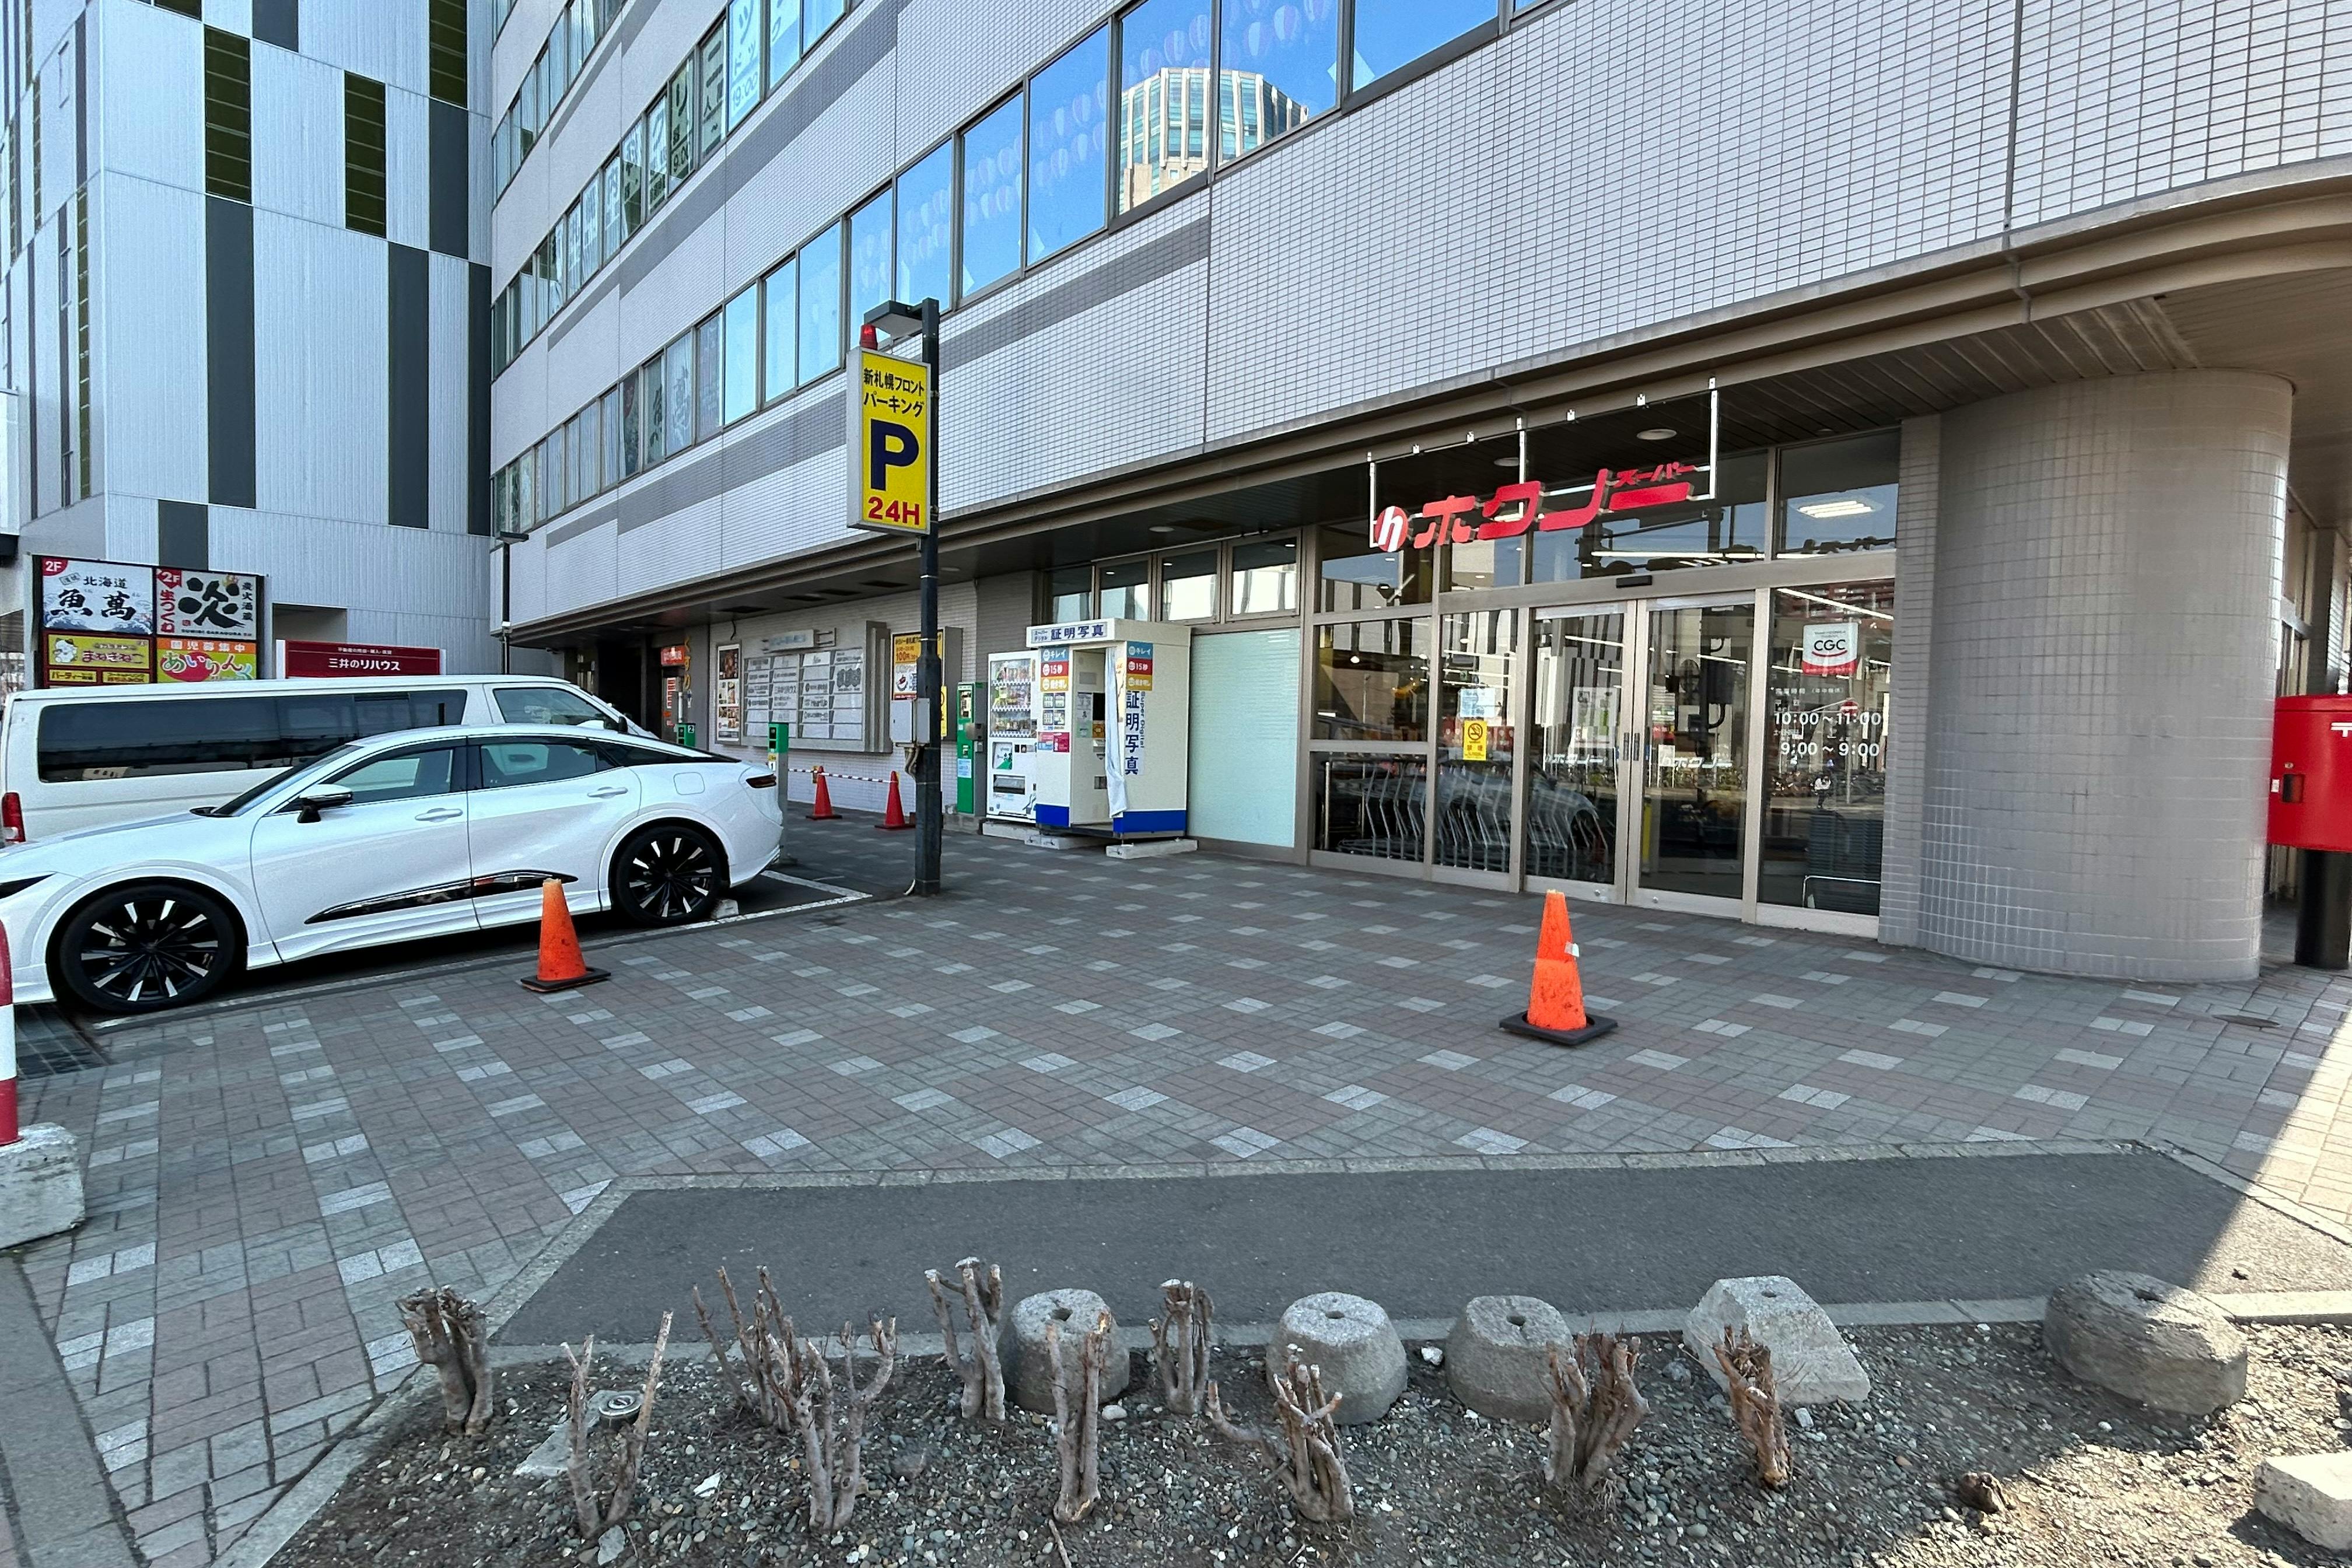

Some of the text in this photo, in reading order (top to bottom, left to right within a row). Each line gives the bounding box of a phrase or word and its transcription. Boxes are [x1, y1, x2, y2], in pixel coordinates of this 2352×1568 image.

[863, 367, 925, 397] 新札幌フロント
[863, 390, 925, 418] パーキング
[870, 418, 919, 491] P
[1613, 461, 1696, 488] スーパー
[867, 496, 920, 526] 24H
[1414, 468, 1692, 549] ホクノー
[46, 561, 62, 572] 2F
[162, 571, 180, 583] 2F
[83, 575, 128, 589] 北海道
[50, 588, 136, 621] 魚萬
[160, 589, 176, 633] 生つくね
[1051, 625, 1104, 640] 証明写真
[1814, 639, 1846, 651] CGC
[82, 650, 144, 664] まねきねこ
[170, 640, 246, 653] 園児募集中
[1050, 649, 1066, 659] キレイ
[162, 650, 243, 676] あいりん
[328, 658, 401, 671] 三井のリハウス
[1125, 691, 1139, 775] 証明写真
